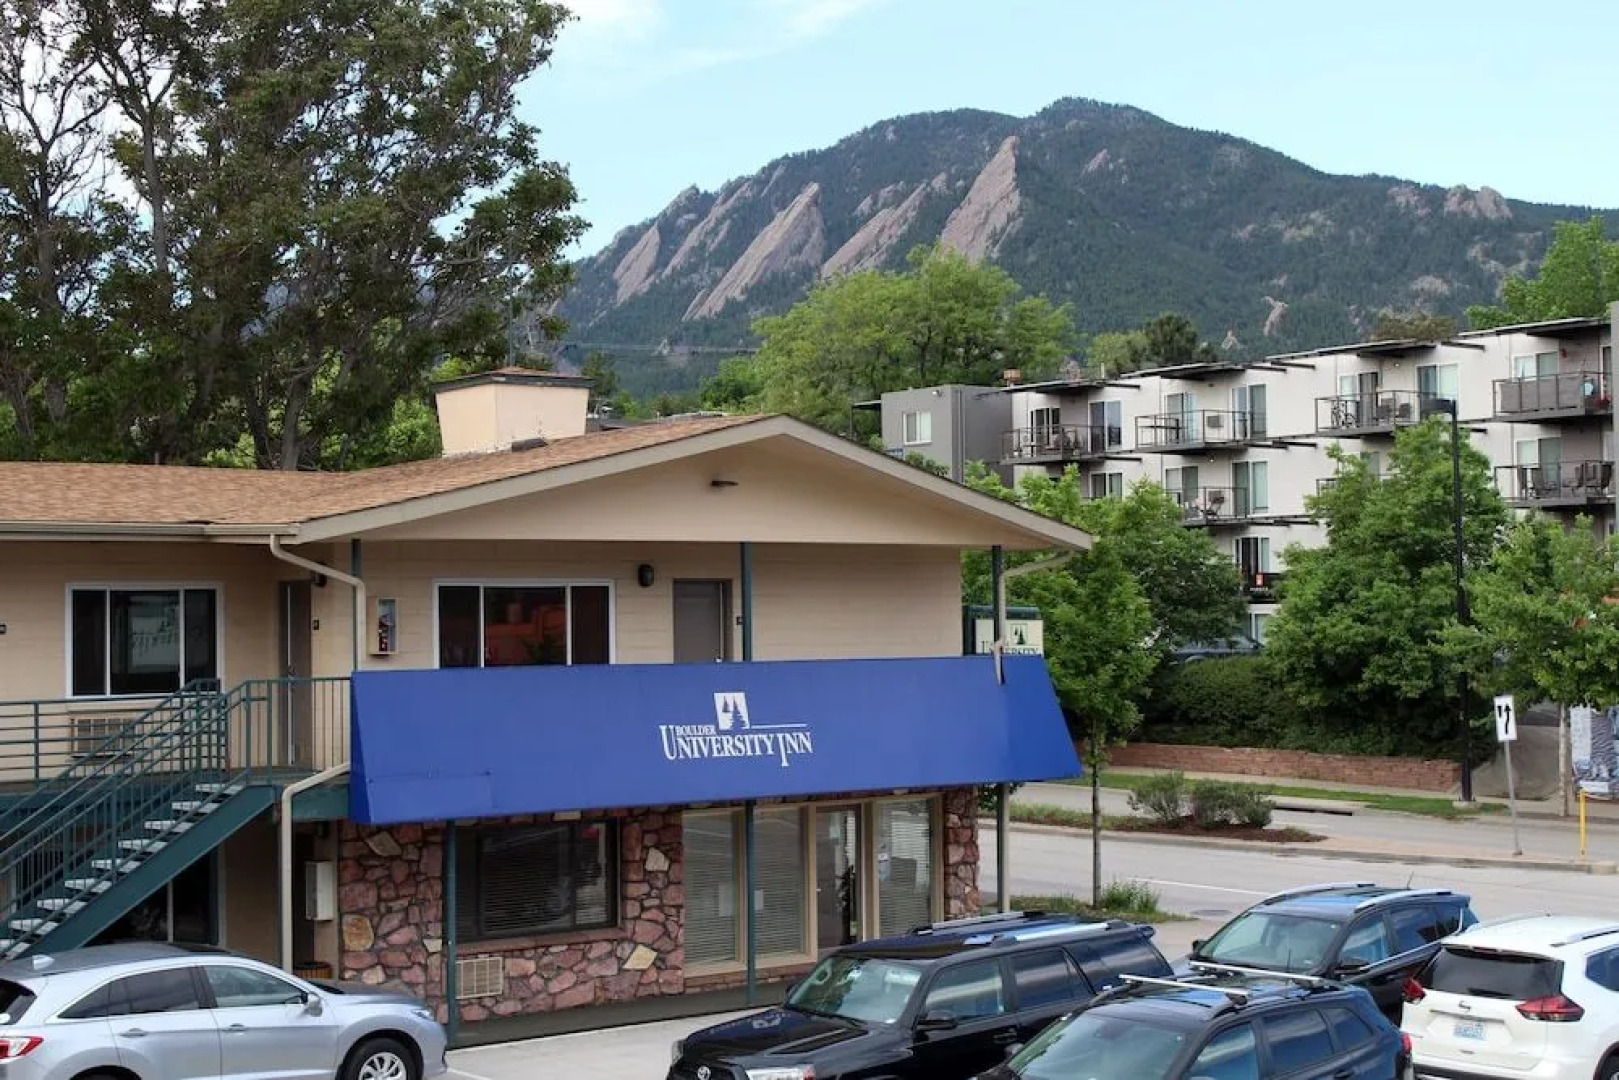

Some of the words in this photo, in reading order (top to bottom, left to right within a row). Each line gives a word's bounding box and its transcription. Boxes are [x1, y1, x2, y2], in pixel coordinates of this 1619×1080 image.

[676, 724, 716, 735] BOULDER
[659, 724, 775, 760] UNIVERSITY
[776, 731, 813, 766] INN
